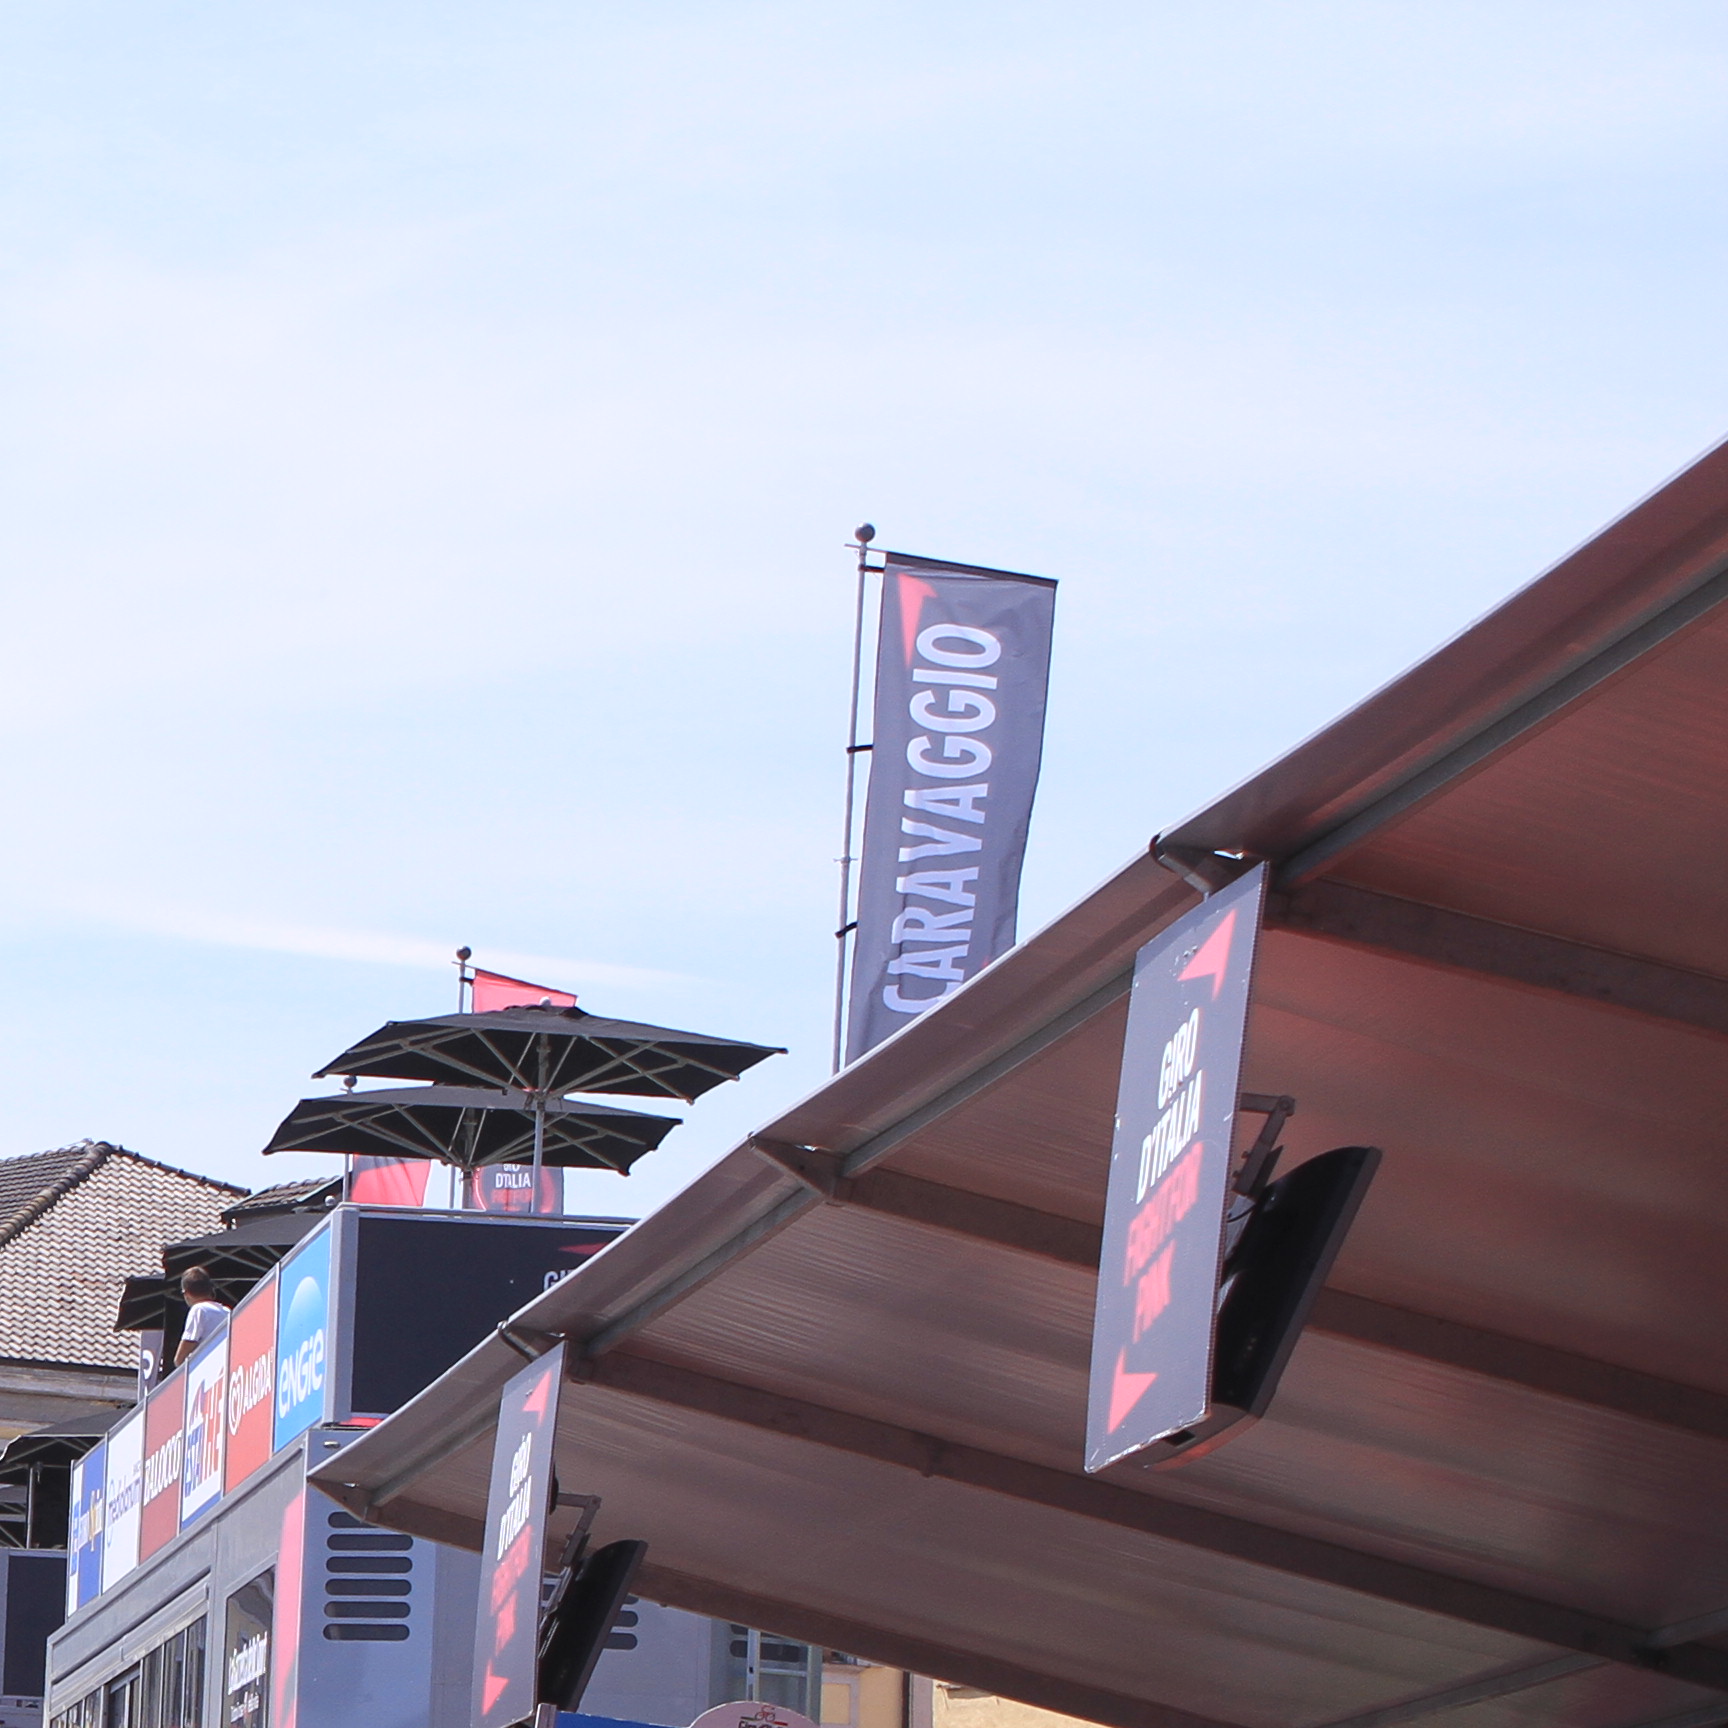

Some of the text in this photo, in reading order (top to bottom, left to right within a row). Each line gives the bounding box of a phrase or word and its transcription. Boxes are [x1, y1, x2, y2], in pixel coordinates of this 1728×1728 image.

[883, 621, 1002, 1018] CARAVAGGIO
[1158, 1008, 1200, 1109] GIRO
[1136, 1069, 1204, 1204] D'ITALIA
